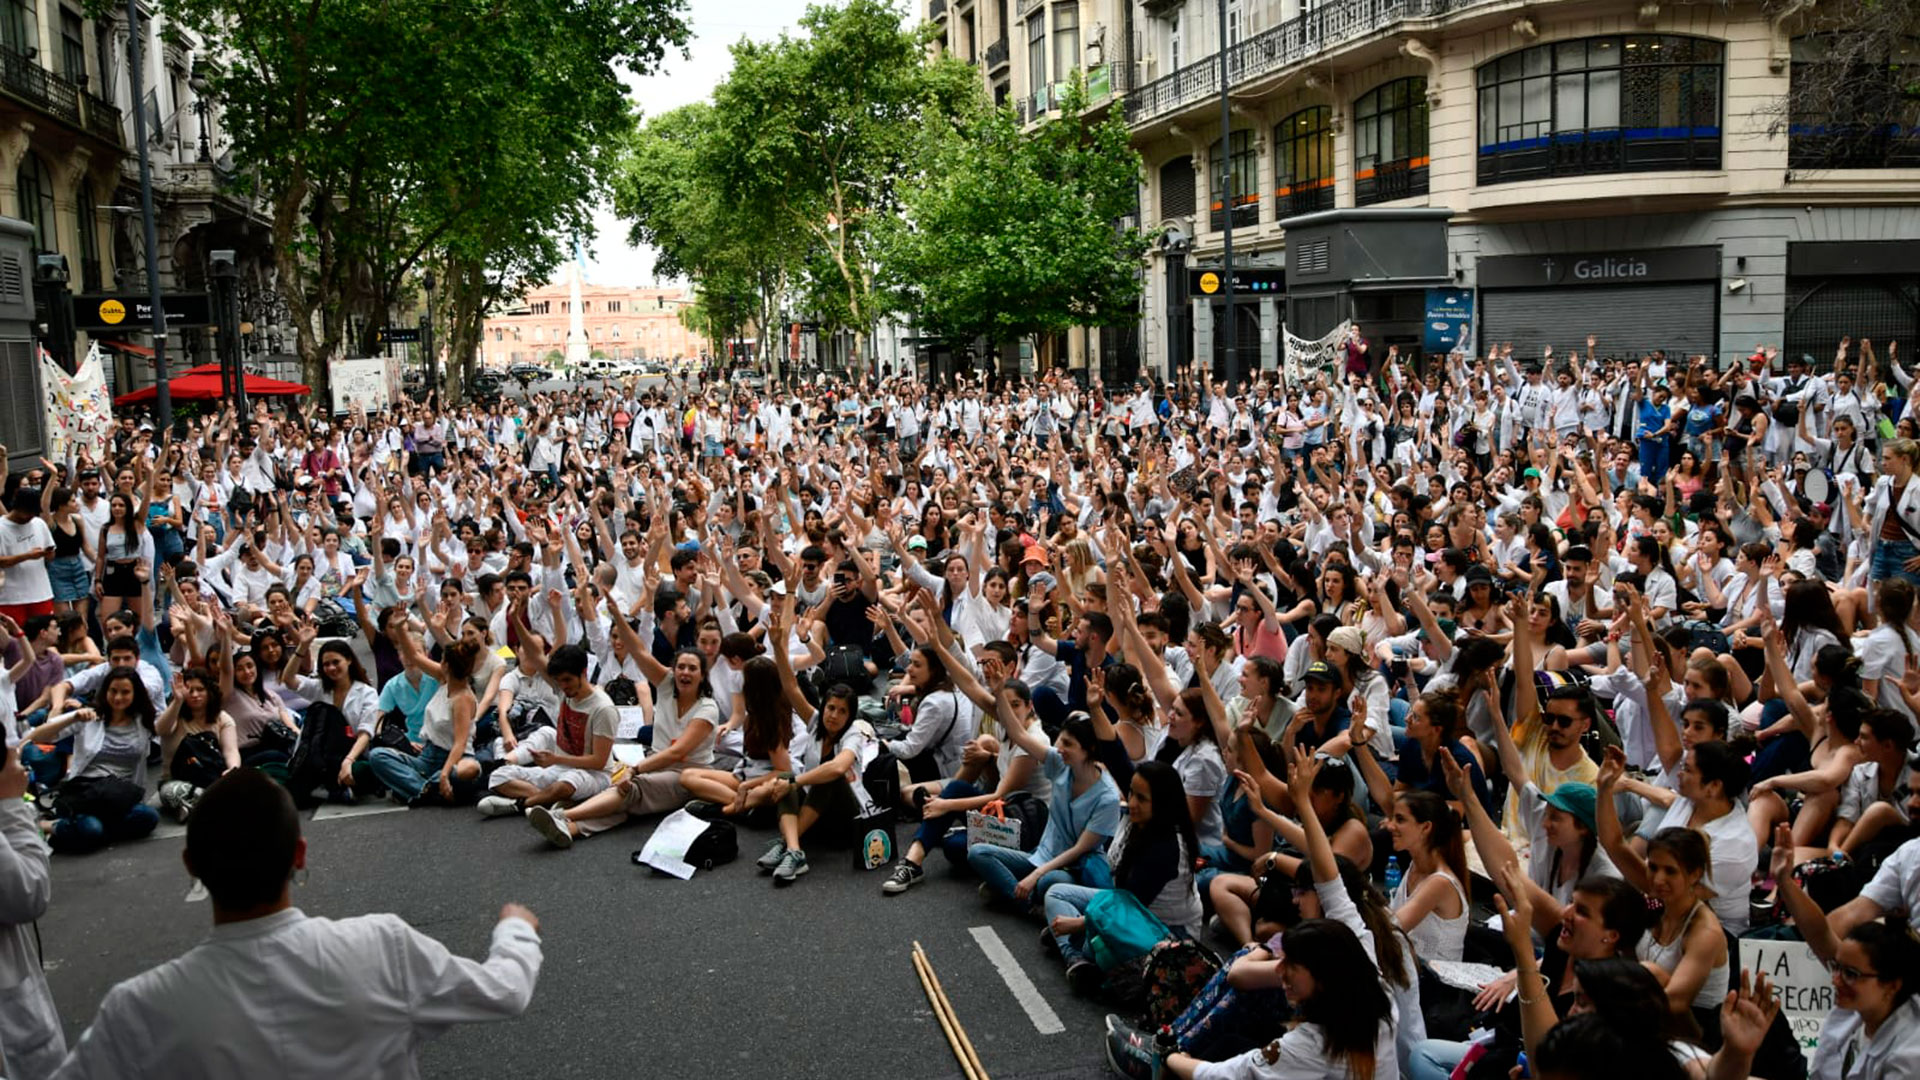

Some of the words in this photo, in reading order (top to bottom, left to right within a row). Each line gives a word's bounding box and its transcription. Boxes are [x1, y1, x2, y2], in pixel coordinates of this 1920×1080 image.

[1574, 258, 1647, 279] Galicia
[136, 304, 152, 313] Per
[1755, 949, 1790, 977] LA
